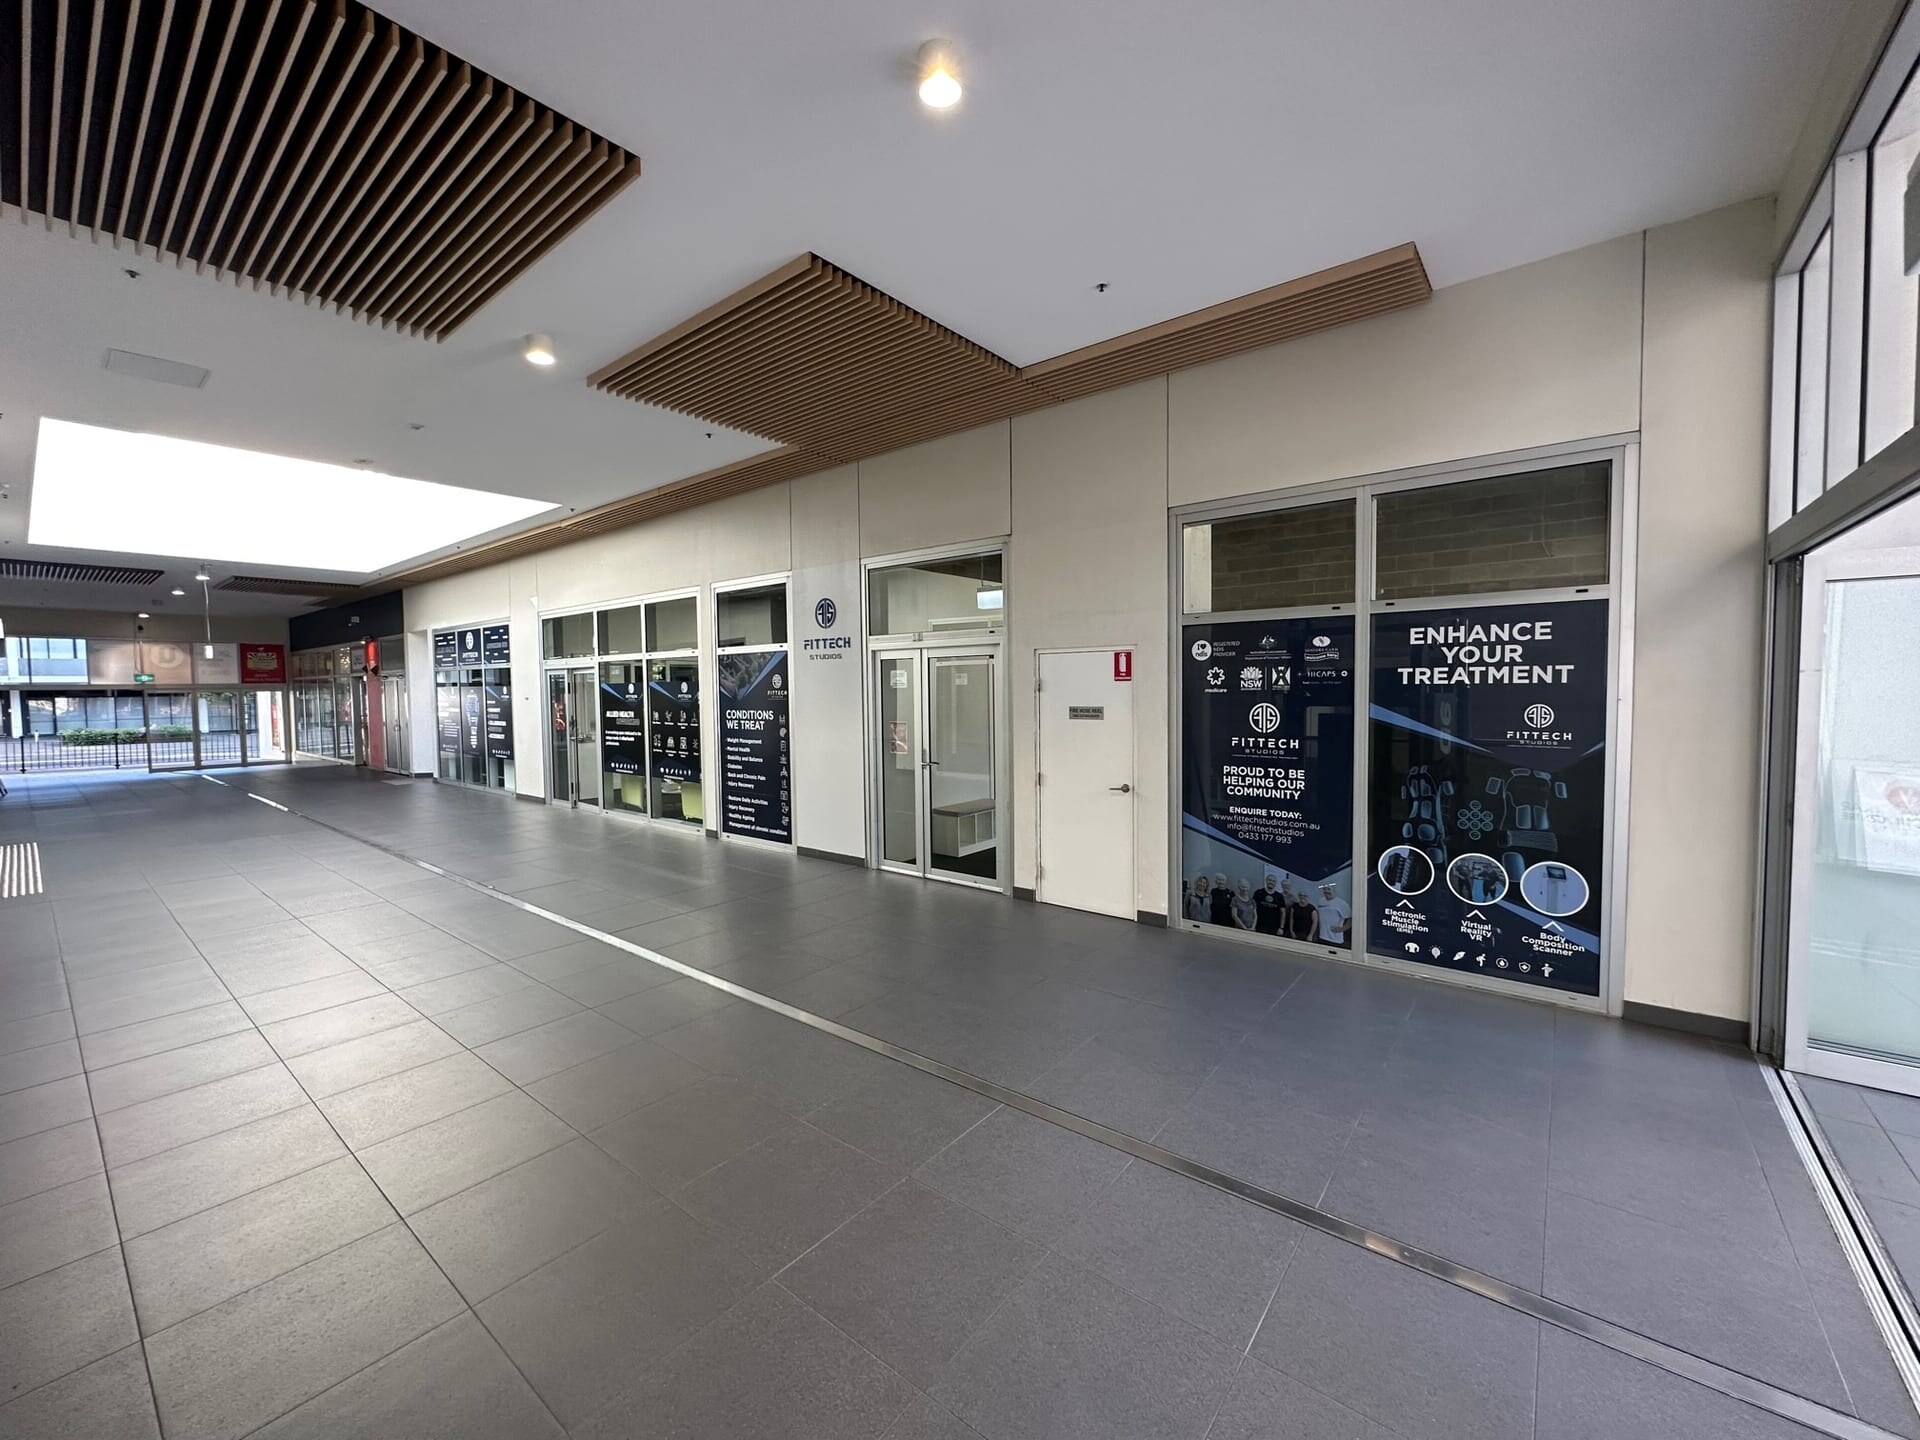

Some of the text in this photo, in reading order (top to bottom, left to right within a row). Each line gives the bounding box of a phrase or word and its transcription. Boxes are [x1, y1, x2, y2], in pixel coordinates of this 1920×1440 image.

[1409, 621, 1553, 645] ENHANCE
[803, 636, 851, 650] FITTECH
[1441, 644, 1523, 664] YOUR
[1397, 665, 1575, 685] TREATMENT
[1240, 680, 1262, 688] NSW
[726, 709, 774, 720] CONDITIONS
[726, 720, 765, 730] WE TREAT
[1506, 731, 1572, 740] FITTECH
[1231, 737, 1299, 749] FITTECH
[1223, 765, 1305, 779] PROUD TO BE
[1223, 776, 1305, 790] HELPING OUR
[1226, 786, 1300, 800] COMMUNITY
[1229, 806, 1302, 819] ENQUIRE TODAY:
[1212, 814, 1320, 830] www.fittechstudios.com.au
[1227, 822, 1304, 837] info@fittechstudios
[1238, 831, 1292, 844] 0433 177 993
[1384, 908, 1427, 920] Electronic
[1391, 914, 1419, 925] Muscle
[1381, 919, 1429, 933] Stimulation
[1460, 926, 1493, 938] Reality
[1461, 920, 1492, 931] Virtual
[1469, 933, 1483, 942] VR
[1539, 932, 1566, 943] Body
[1521, 936, 1585, 953] Composition
[1532, 944, 1573, 957] Scanner
